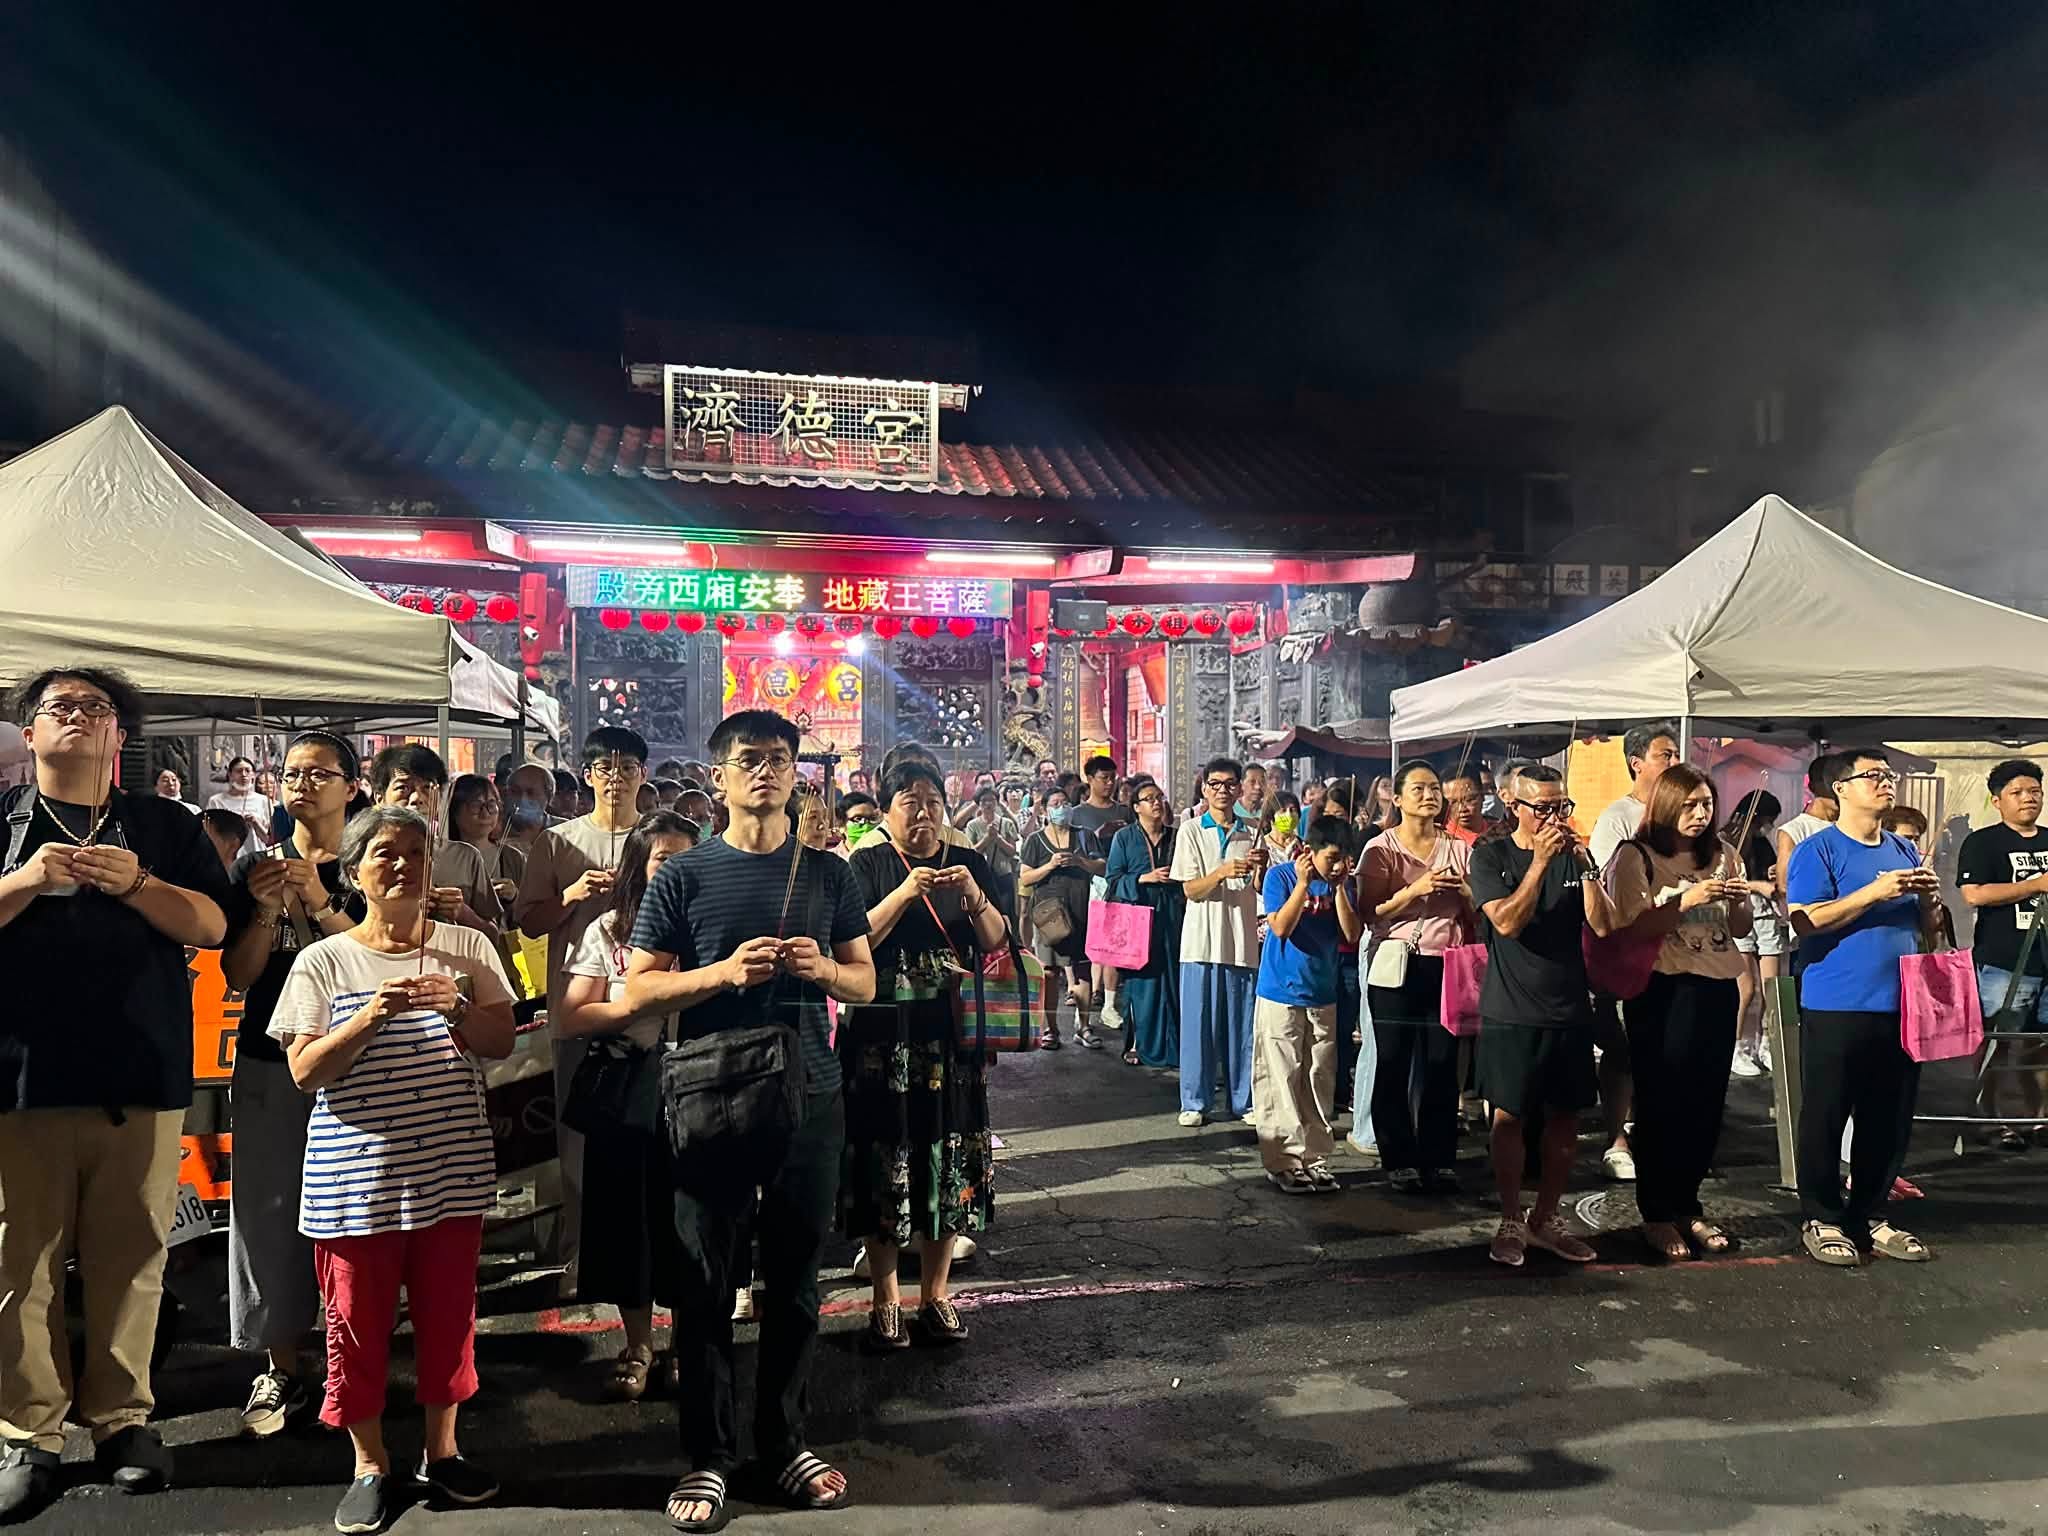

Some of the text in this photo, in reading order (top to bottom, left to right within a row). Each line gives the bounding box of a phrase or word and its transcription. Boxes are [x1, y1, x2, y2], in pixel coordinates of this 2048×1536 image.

[679, 382, 925, 466] 濟德宮
[594, 571, 987, 614] 殿旁西廂安奉 地藏王菩薩
